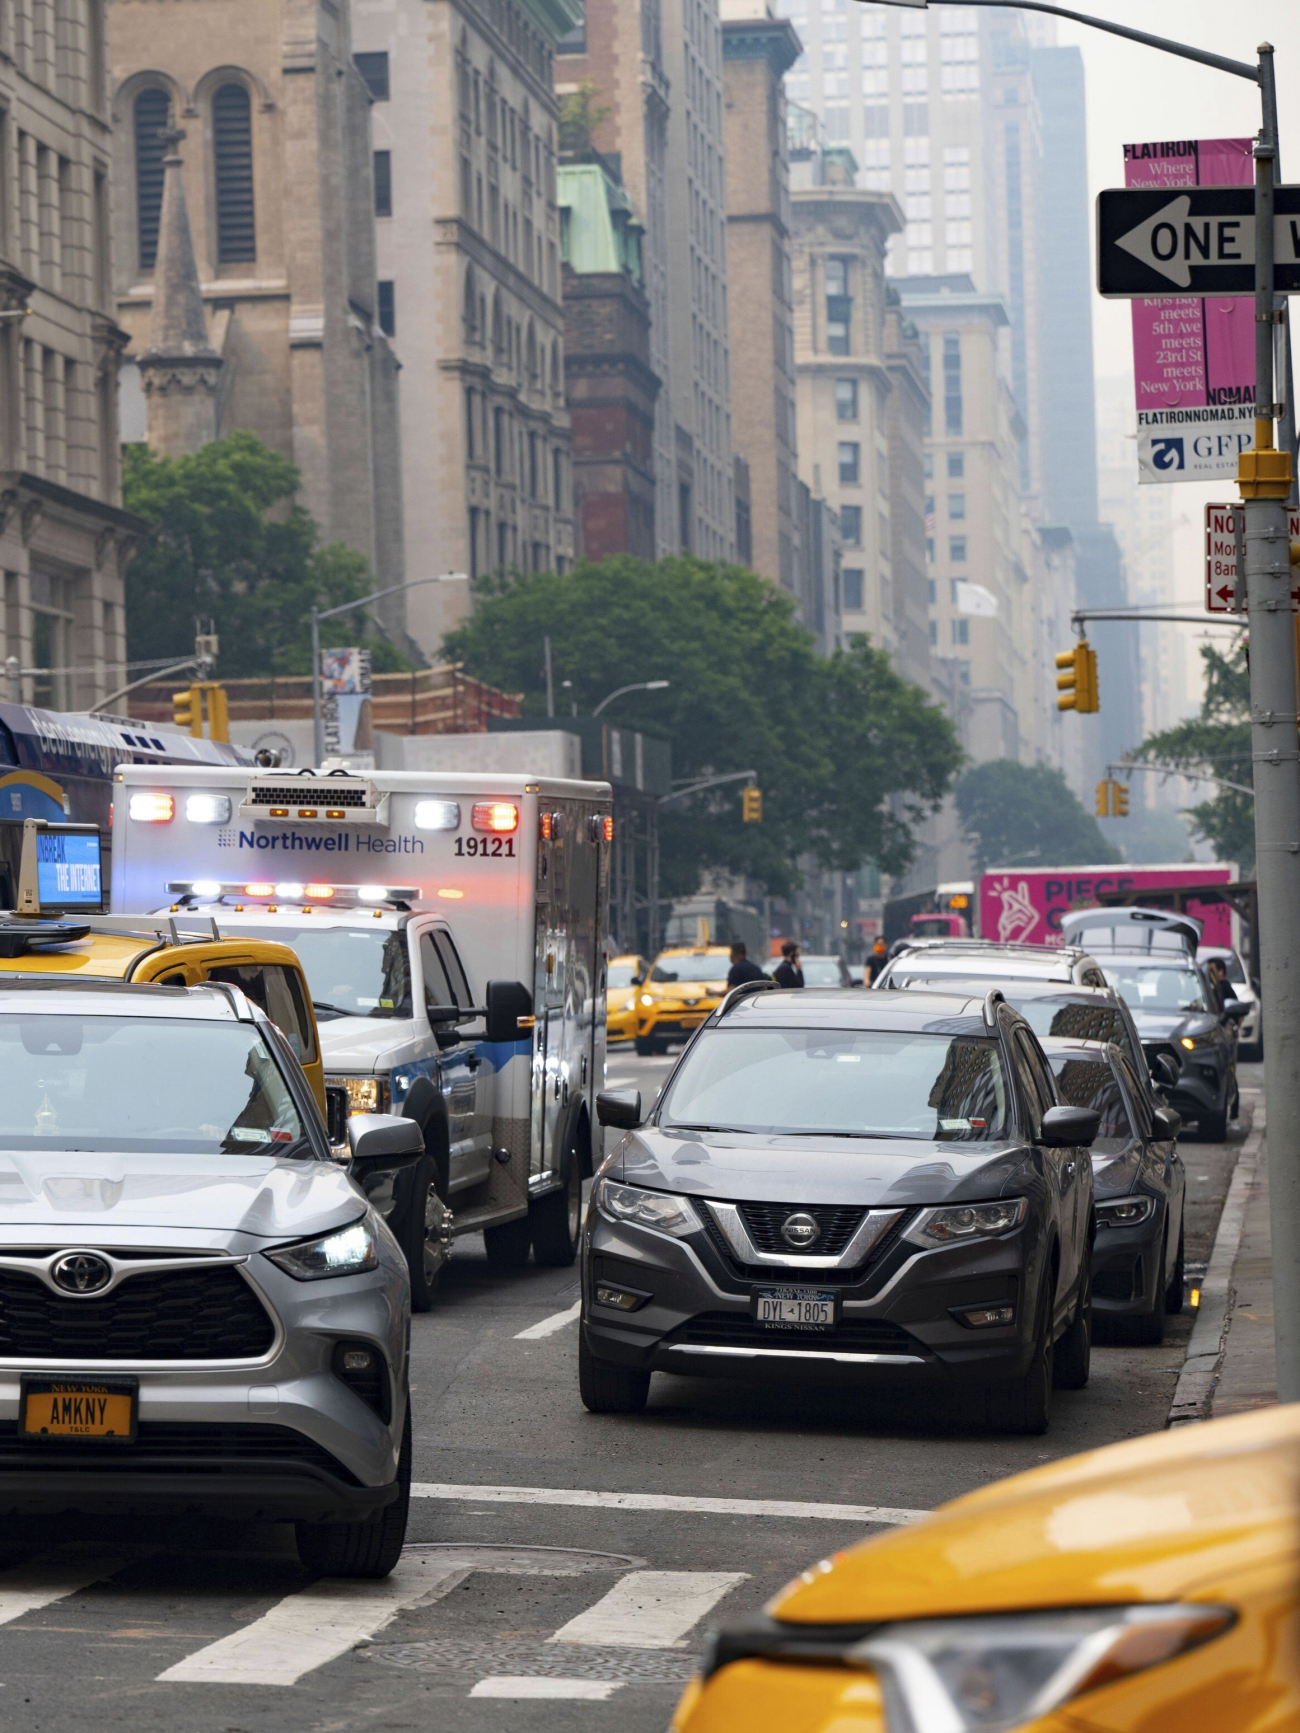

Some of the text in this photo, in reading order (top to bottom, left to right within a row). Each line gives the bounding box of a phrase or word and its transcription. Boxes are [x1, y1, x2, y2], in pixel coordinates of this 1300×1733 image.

[1123, 140, 1198, 160] FLATIRON
[1149, 162, 1193, 175] Where
[1131, 175, 1193, 187] New York
[1151, 222, 1241, 261] ONE
[1144, 297, 1172, 309] Kips
[1161, 309, 1200, 320] meets
[1152, 321, 1201, 335] 5th Ave
[1162, 337, 1201, 349] meets
[1156, 350, 1202, 364] 23rd St
[1163, 366, 1202, 378] meets
[1141, 379, 1204, 393] New York
[1193, 434, 1252, 458] GFP
[1214, 515, 1235, 533] NO
[239, 831, 424, 853] Northwell Health
[455, 837, 516, 857] 19121
[56, 864, 100, 891] THE INTERNET
[763, 1301, 828, 1322] DYL 1805
[52, 1384, 108, 1393] NEW YORK
[51, 1397, 107, 1425] AMKNY
